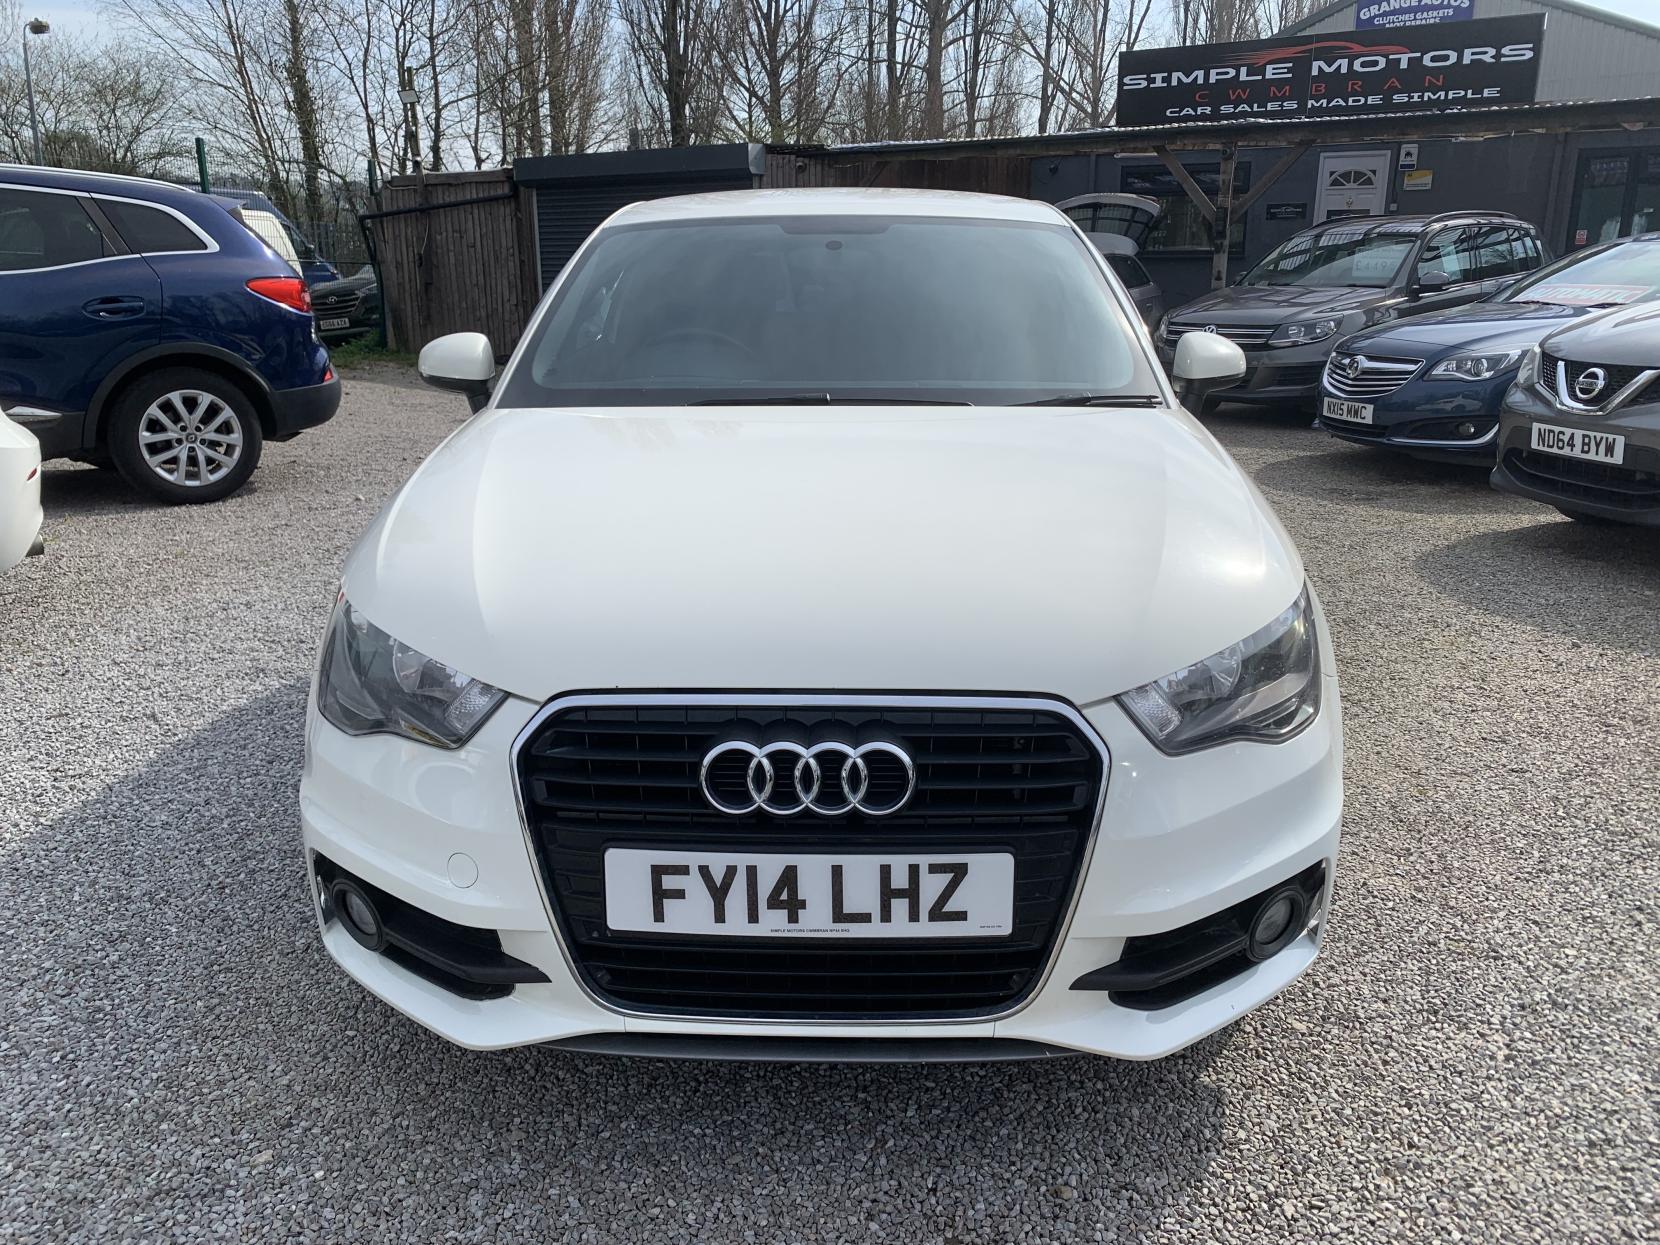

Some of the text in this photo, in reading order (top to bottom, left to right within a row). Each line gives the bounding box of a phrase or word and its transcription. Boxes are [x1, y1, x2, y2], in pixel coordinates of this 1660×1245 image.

[1374, 9, 1453, 25] CLUTCHES GASKETS
[1123, 43, 1535, 90] SIMPLE MOTORS
[1165, 87, 1501, 117] CAR SALES MADE SIMPLE
[1195, 75, 1444, 102] CWMBRAN
[1327, 400, 1367, 420] NX15 MWC
[1537, 427, 1617, 458] ND64 BYW
[650, 862, 969, 924] FY14 LHZ
